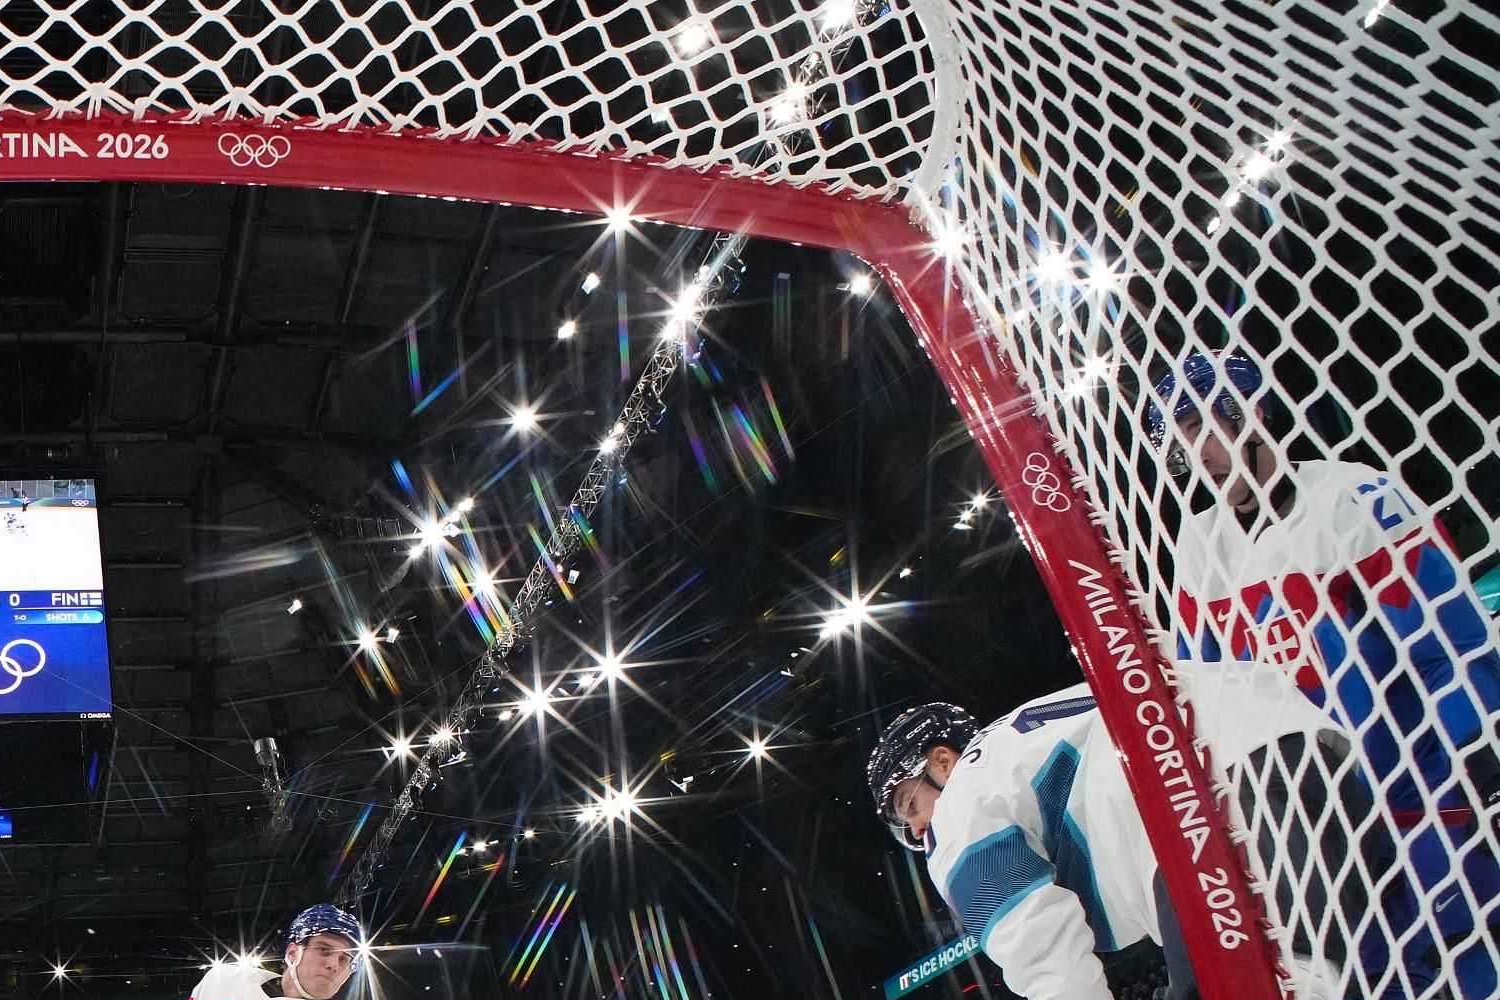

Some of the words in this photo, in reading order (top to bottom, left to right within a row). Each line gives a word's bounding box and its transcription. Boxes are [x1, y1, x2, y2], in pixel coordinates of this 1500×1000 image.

[96, 132, 170, 160] 2026
[9, 593, 20, 607] 0
[51, 592, 79, 606] FIN
[45, 613, 79, 622] SHOTS
[1068, 559, 1151, 694] MILANO
[1135, 700, 1212, 864] CORTINA
[1197, 867, 1249, 950] 2026
[899, 968, 920, 991] IT'S
[919, 956, 938, 979] ICE
[938, 935, 979, 968] HOCKE
